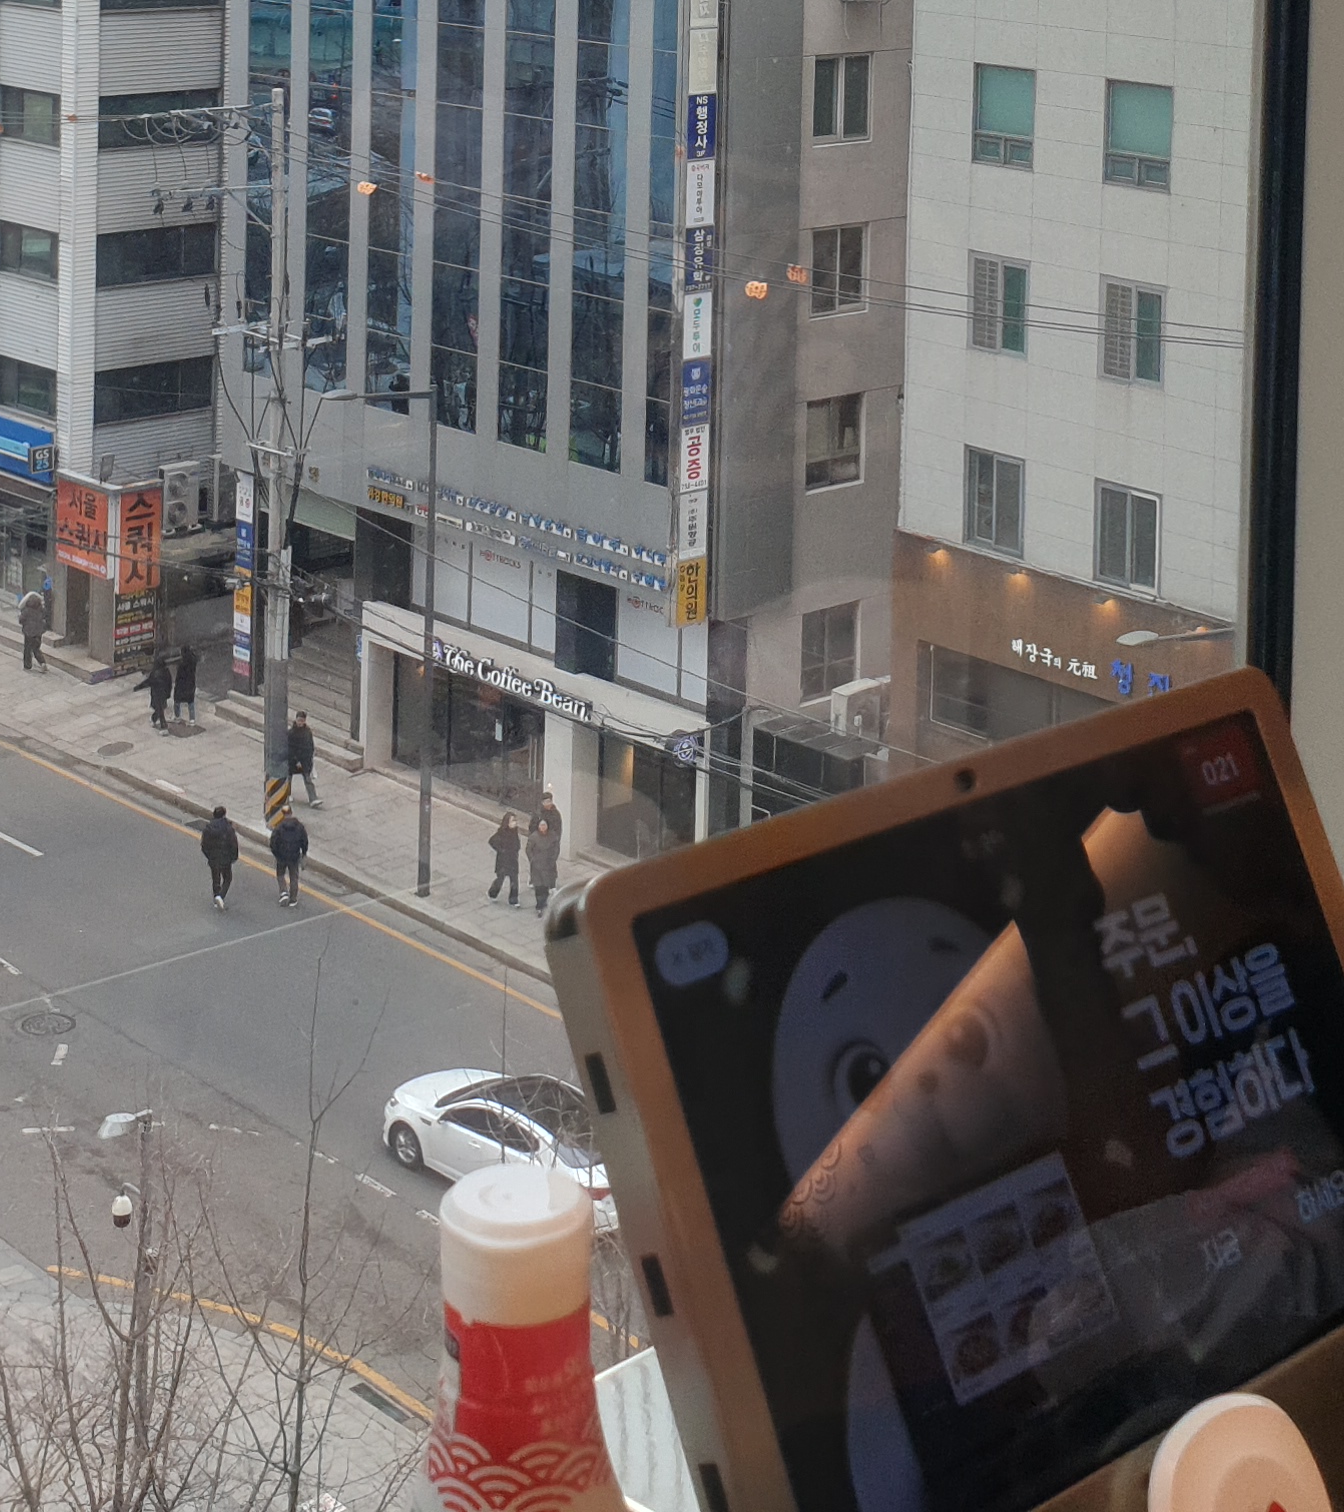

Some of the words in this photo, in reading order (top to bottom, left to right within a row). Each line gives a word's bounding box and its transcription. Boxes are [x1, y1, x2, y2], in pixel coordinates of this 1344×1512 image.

[696, 96, 708, 105] NS
[694, 106, 708, 149] 행정사
[35, 450, 50, 460] GS
[35, 459, 49, 470] 25
[686, 436, 703, 480] 공증
[69, 489, 98, 520] 서울
[57, 517, 107, 563] 스쿼시
[125, 493, 156, 587] 스쿼시
[685, 562, 699, 620] 한의원
[442, 643, 475, 676] The
[476, 656, 534, 698] Coffee
[1011, 638, 1062, 670] 해장국의
[1067, 658, 1099, 680] 元祖
[1199, 756, 1240, 788] 021
[1148, 1026, 1316, 1161] 경험하다
